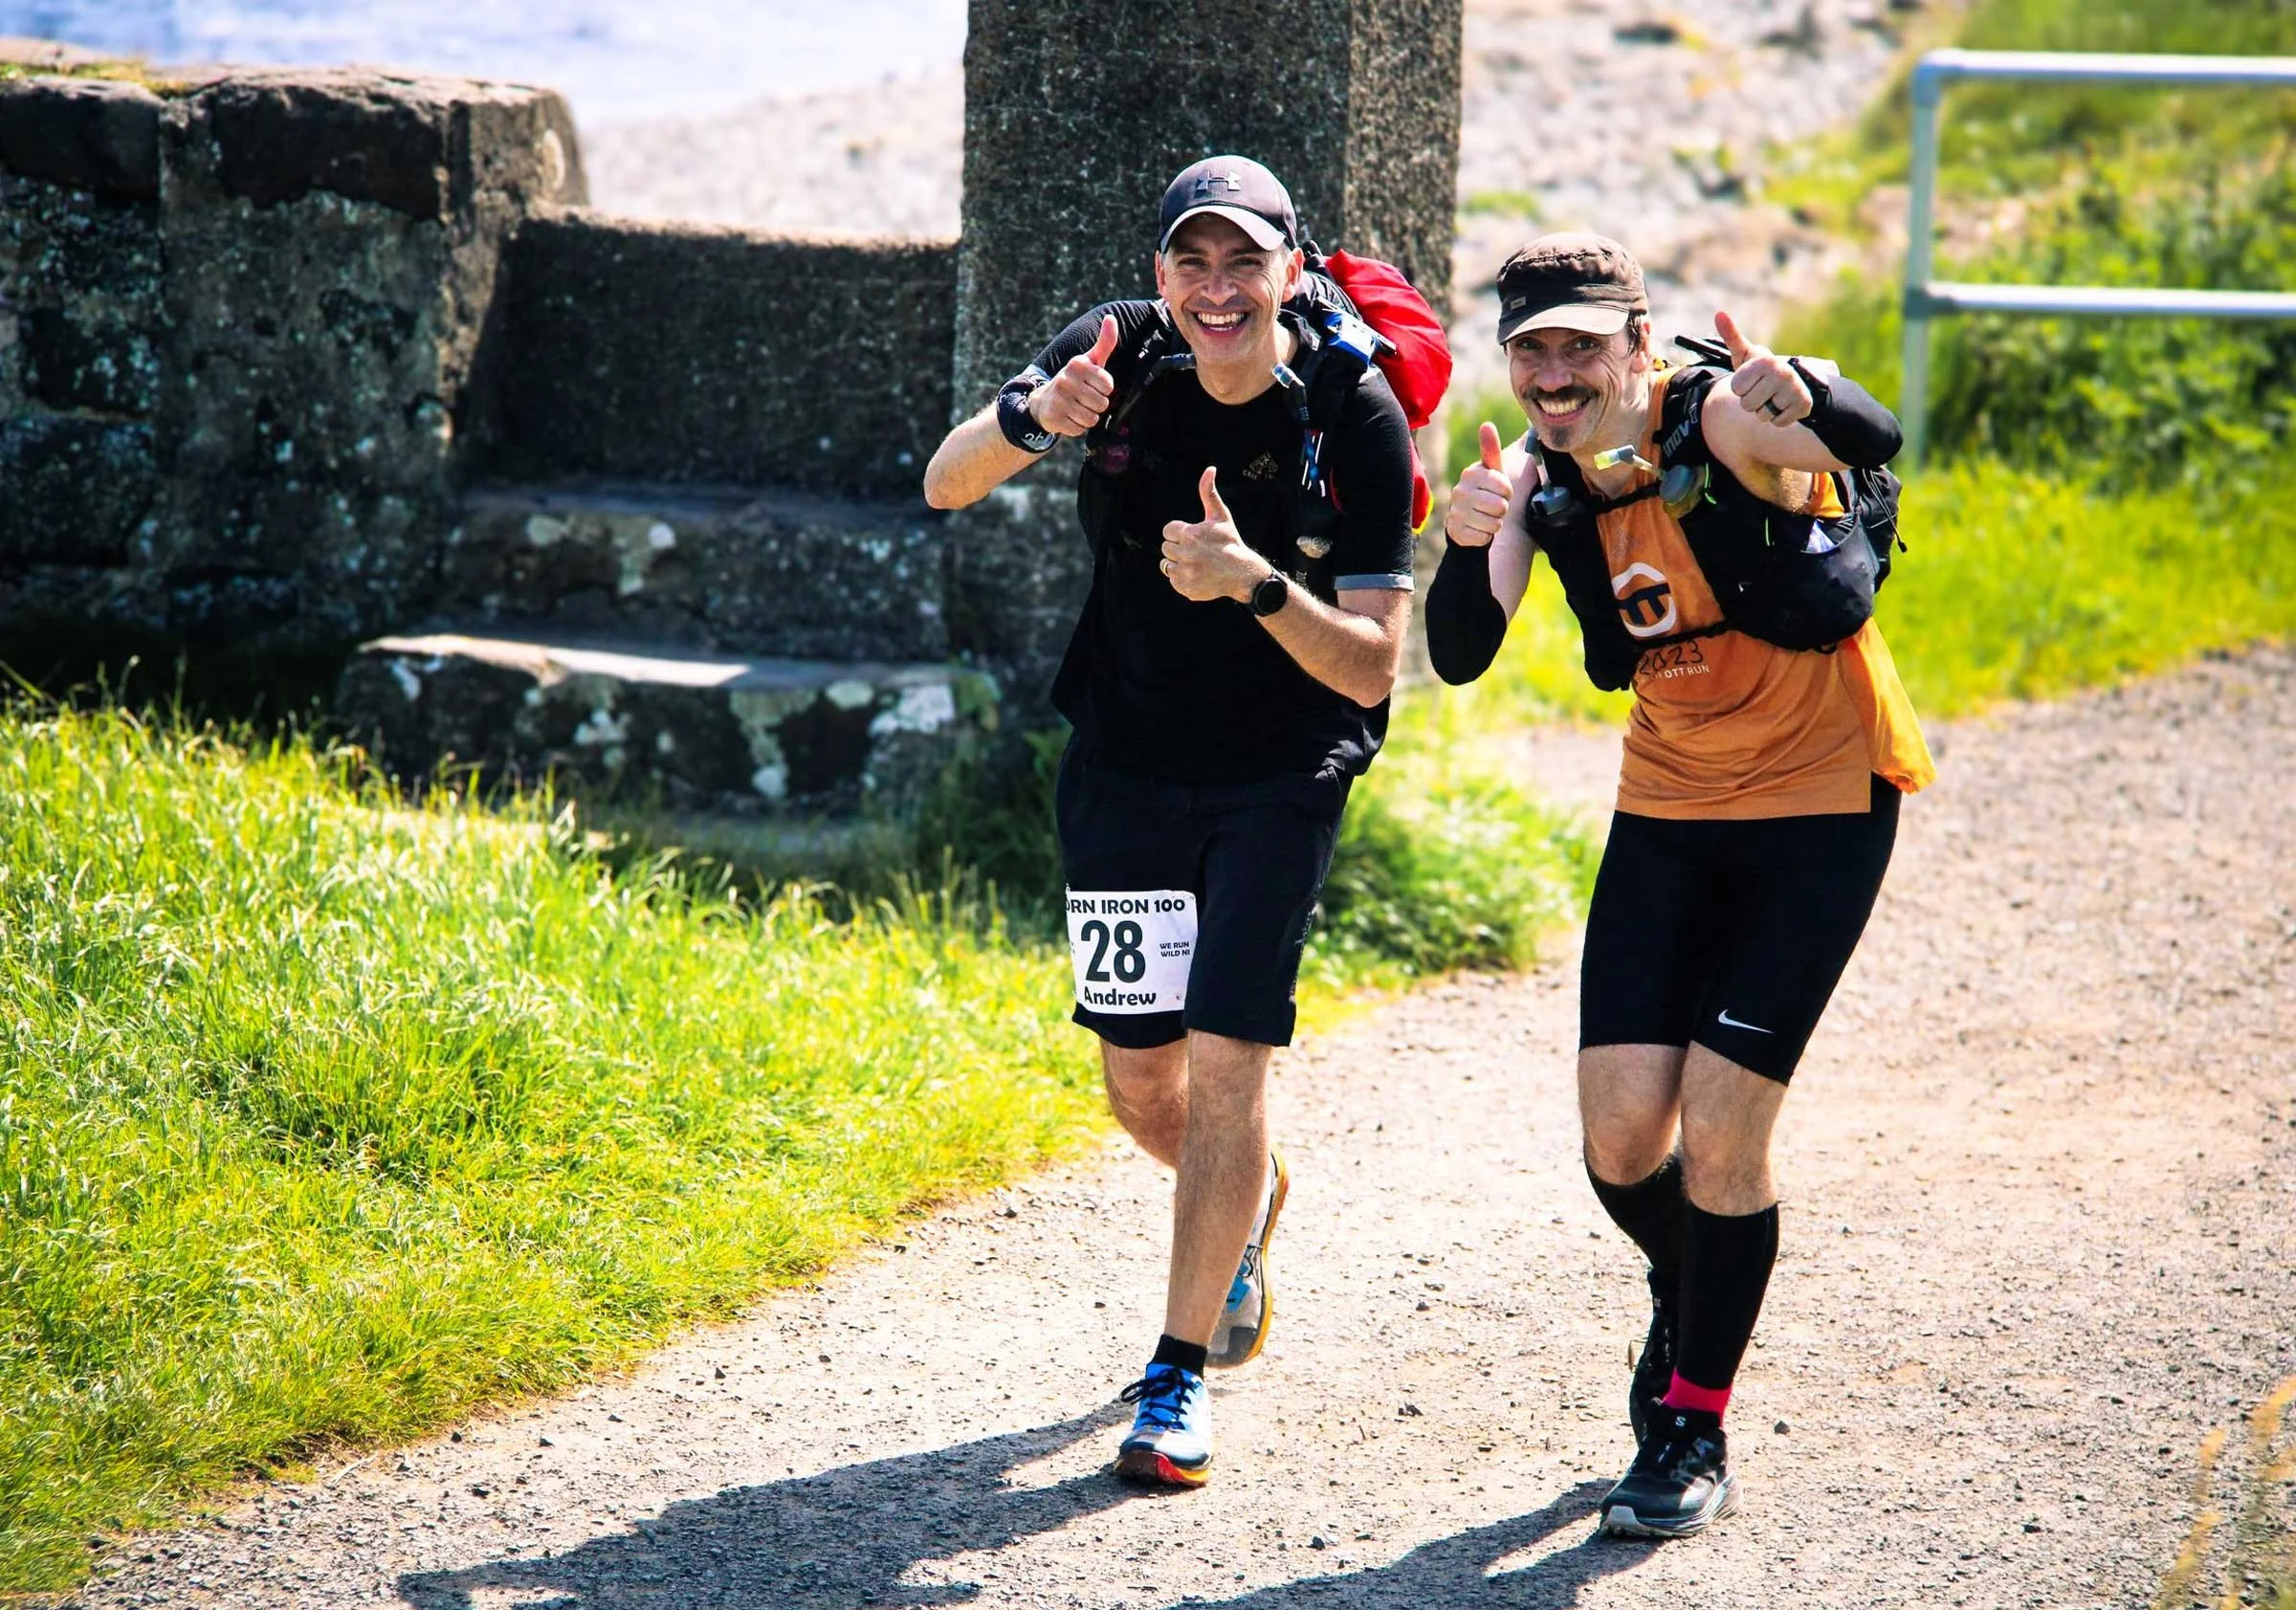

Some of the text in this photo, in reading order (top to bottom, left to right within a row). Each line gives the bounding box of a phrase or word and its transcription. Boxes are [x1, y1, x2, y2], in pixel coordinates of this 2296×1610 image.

[1687, 664, 1711, 675] RUN
[1101, 899, 1149, 914] IRON
[1154, 899, 1185, 913] 100
[1081, 919, 1146, 983] 28
[1084, 986, 1157, 1005] Andrew
[1675, 1416, 1687, 1427] S
